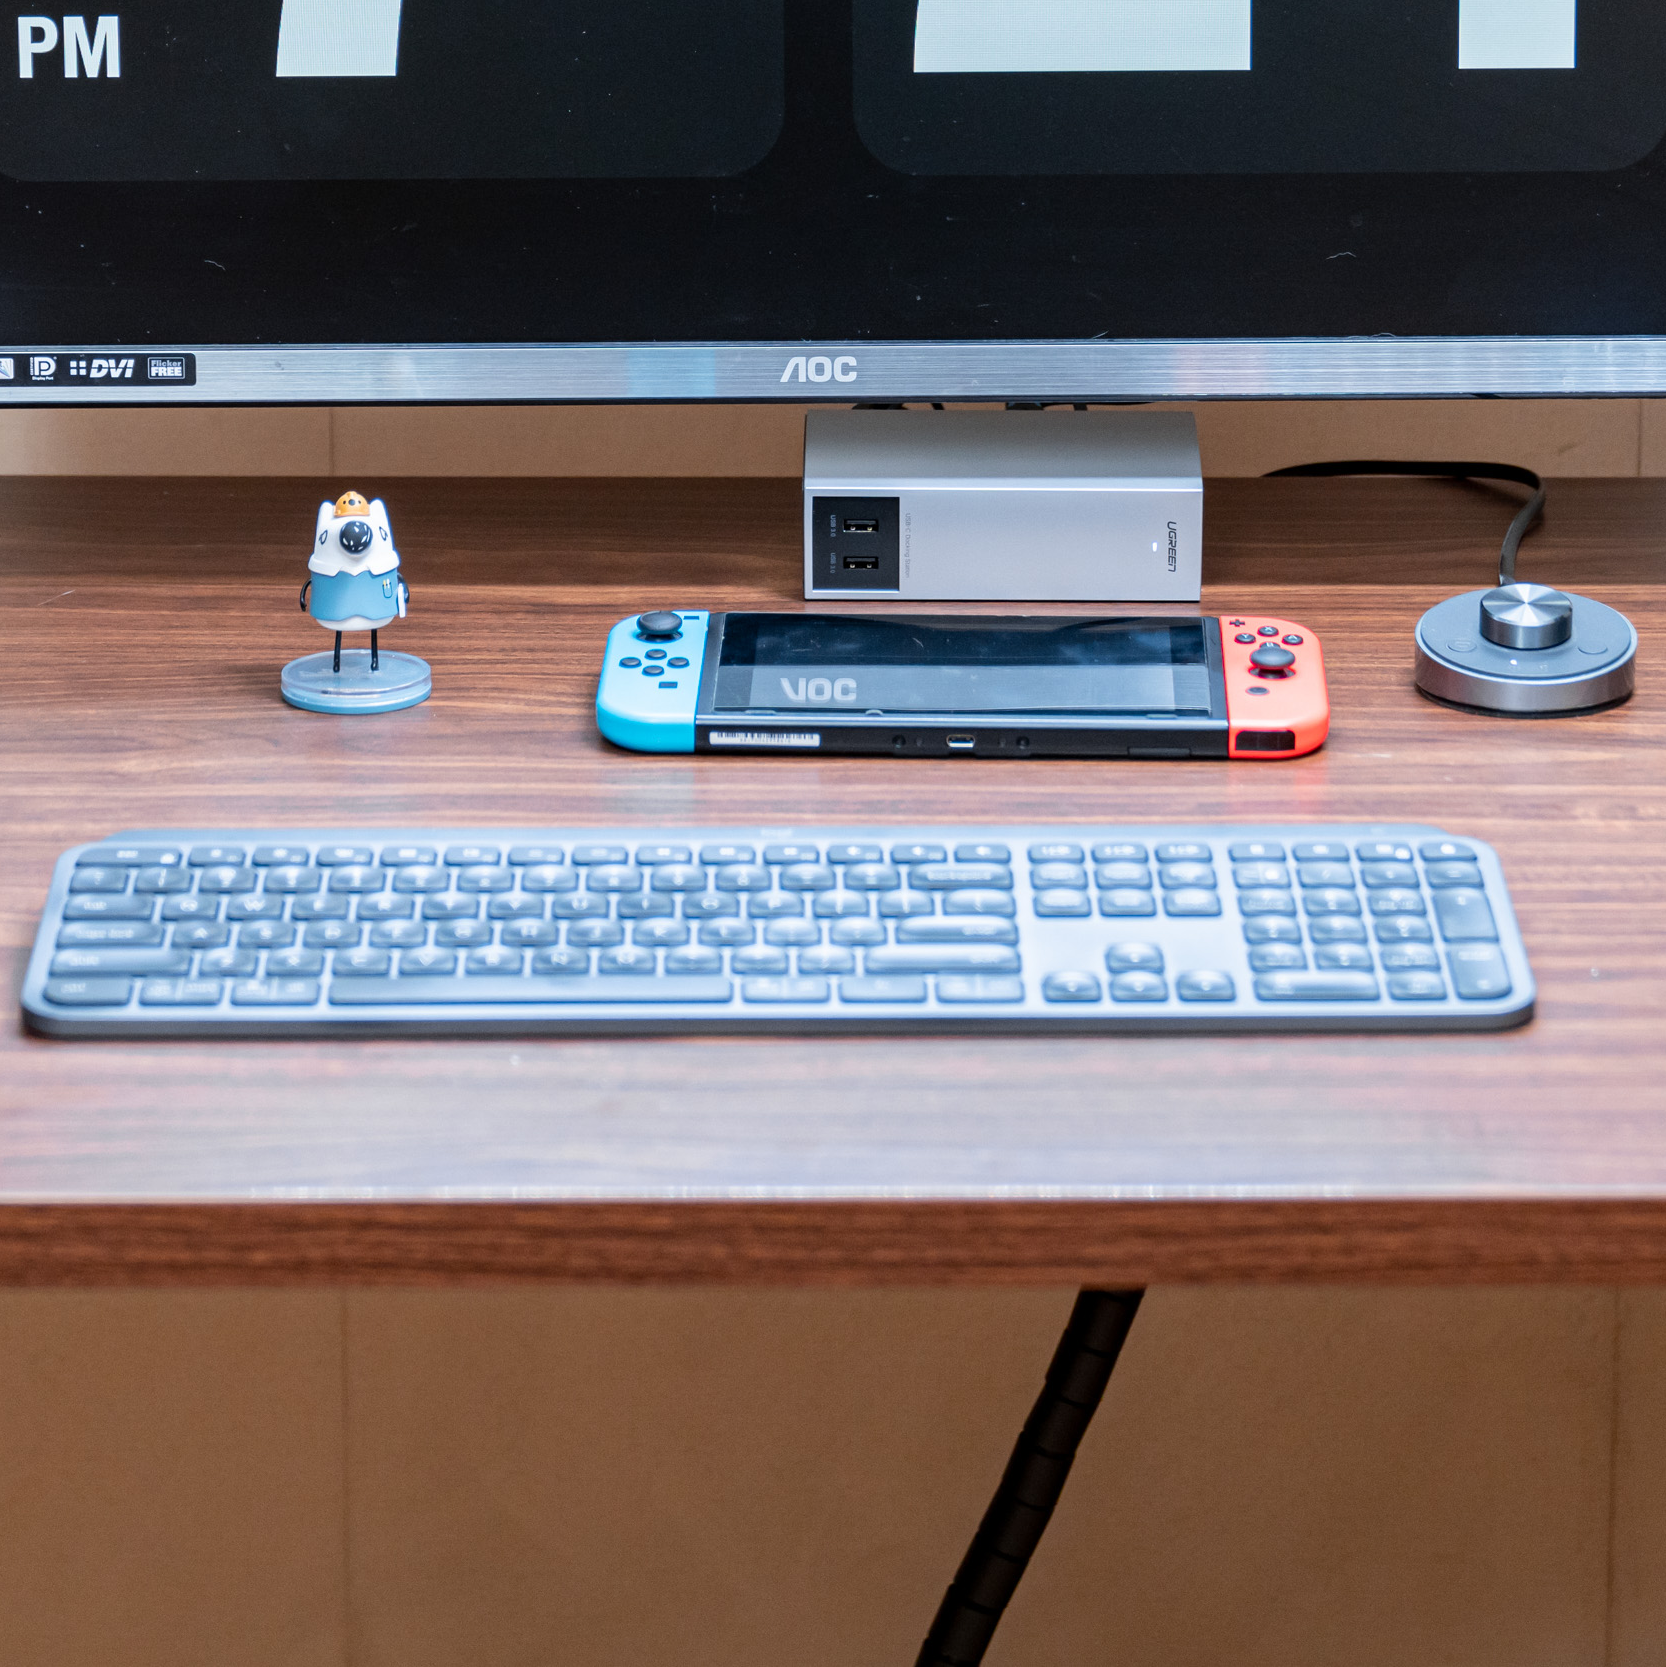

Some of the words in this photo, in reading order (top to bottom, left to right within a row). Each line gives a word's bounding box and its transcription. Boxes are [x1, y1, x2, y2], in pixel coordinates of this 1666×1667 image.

[18, 16, 120, 78] PM
[90, 359, 135, 378] DVI
[151, 367, 182, 377] FREE
[780, 356, 857, 382] AOC
[1167, 521, 1177, 572] UGREEN
